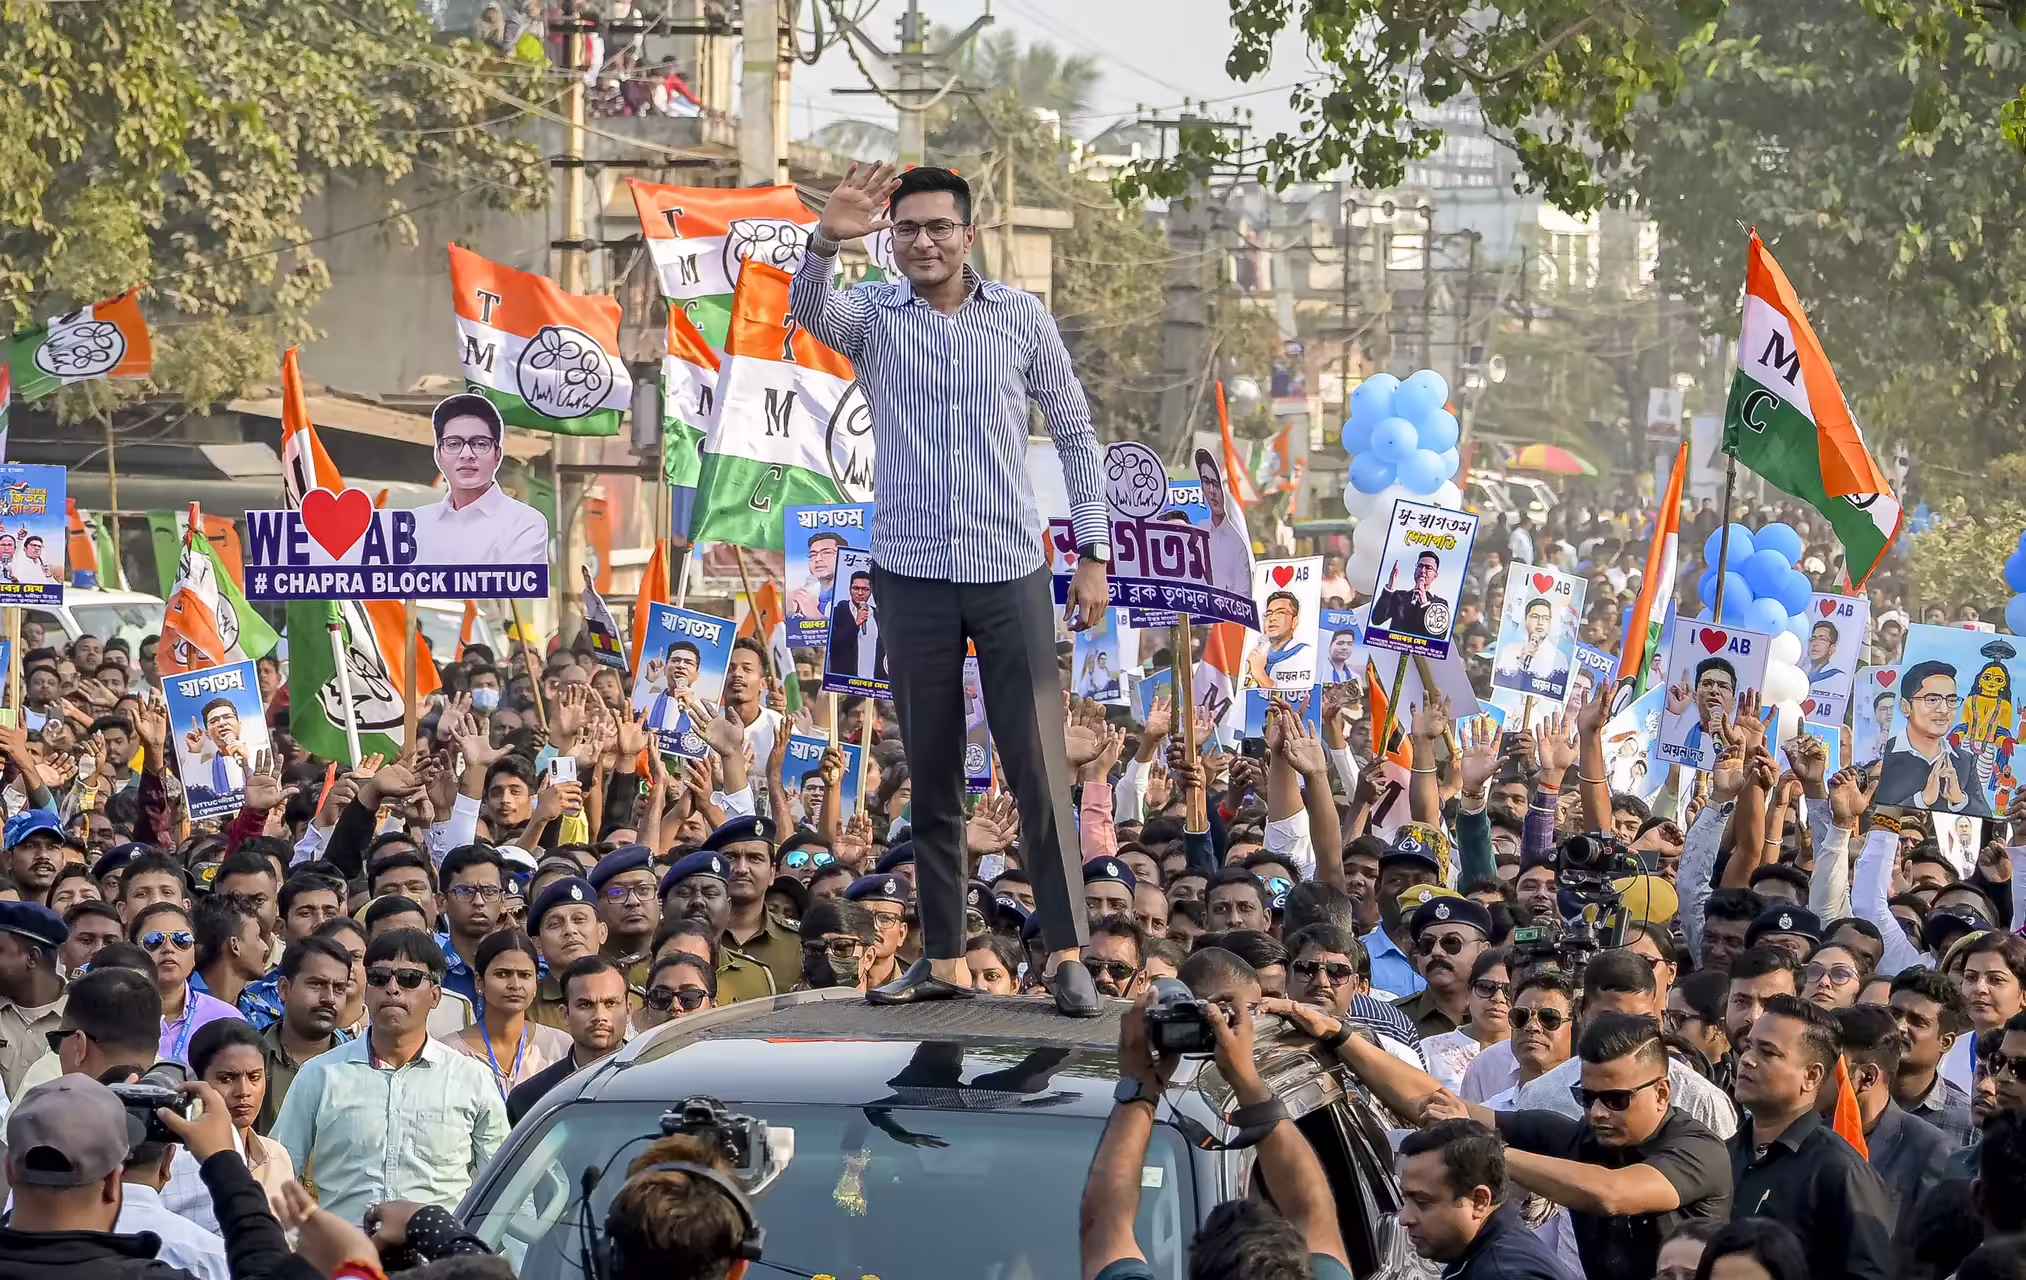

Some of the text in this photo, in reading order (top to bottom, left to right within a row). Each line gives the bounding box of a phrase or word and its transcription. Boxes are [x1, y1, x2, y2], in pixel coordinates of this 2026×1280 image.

[247, 511, 418, 565] WE AB
[274, 572, 365, 594] CHAPRA
[372, 571, 447, 593] BLOCK
[454, 570, 538, 592] INTTUC
[1265, 566, 1309, 584] I AB
[1525, 574, 1571, 595] I AB
[1128, 582, 1157, 603] ব্লক
[1160, 586, 1209, 611] তৃণমূল
[1211, 592, 1254, 621] কংগ্রেস
[1814, 600, 1854, 617] I AB
[1690, 629, 1751, 655] I AB
[1816, 703, 1831, 716] AB
[1662, 743, 1688, 758] অয়ন
